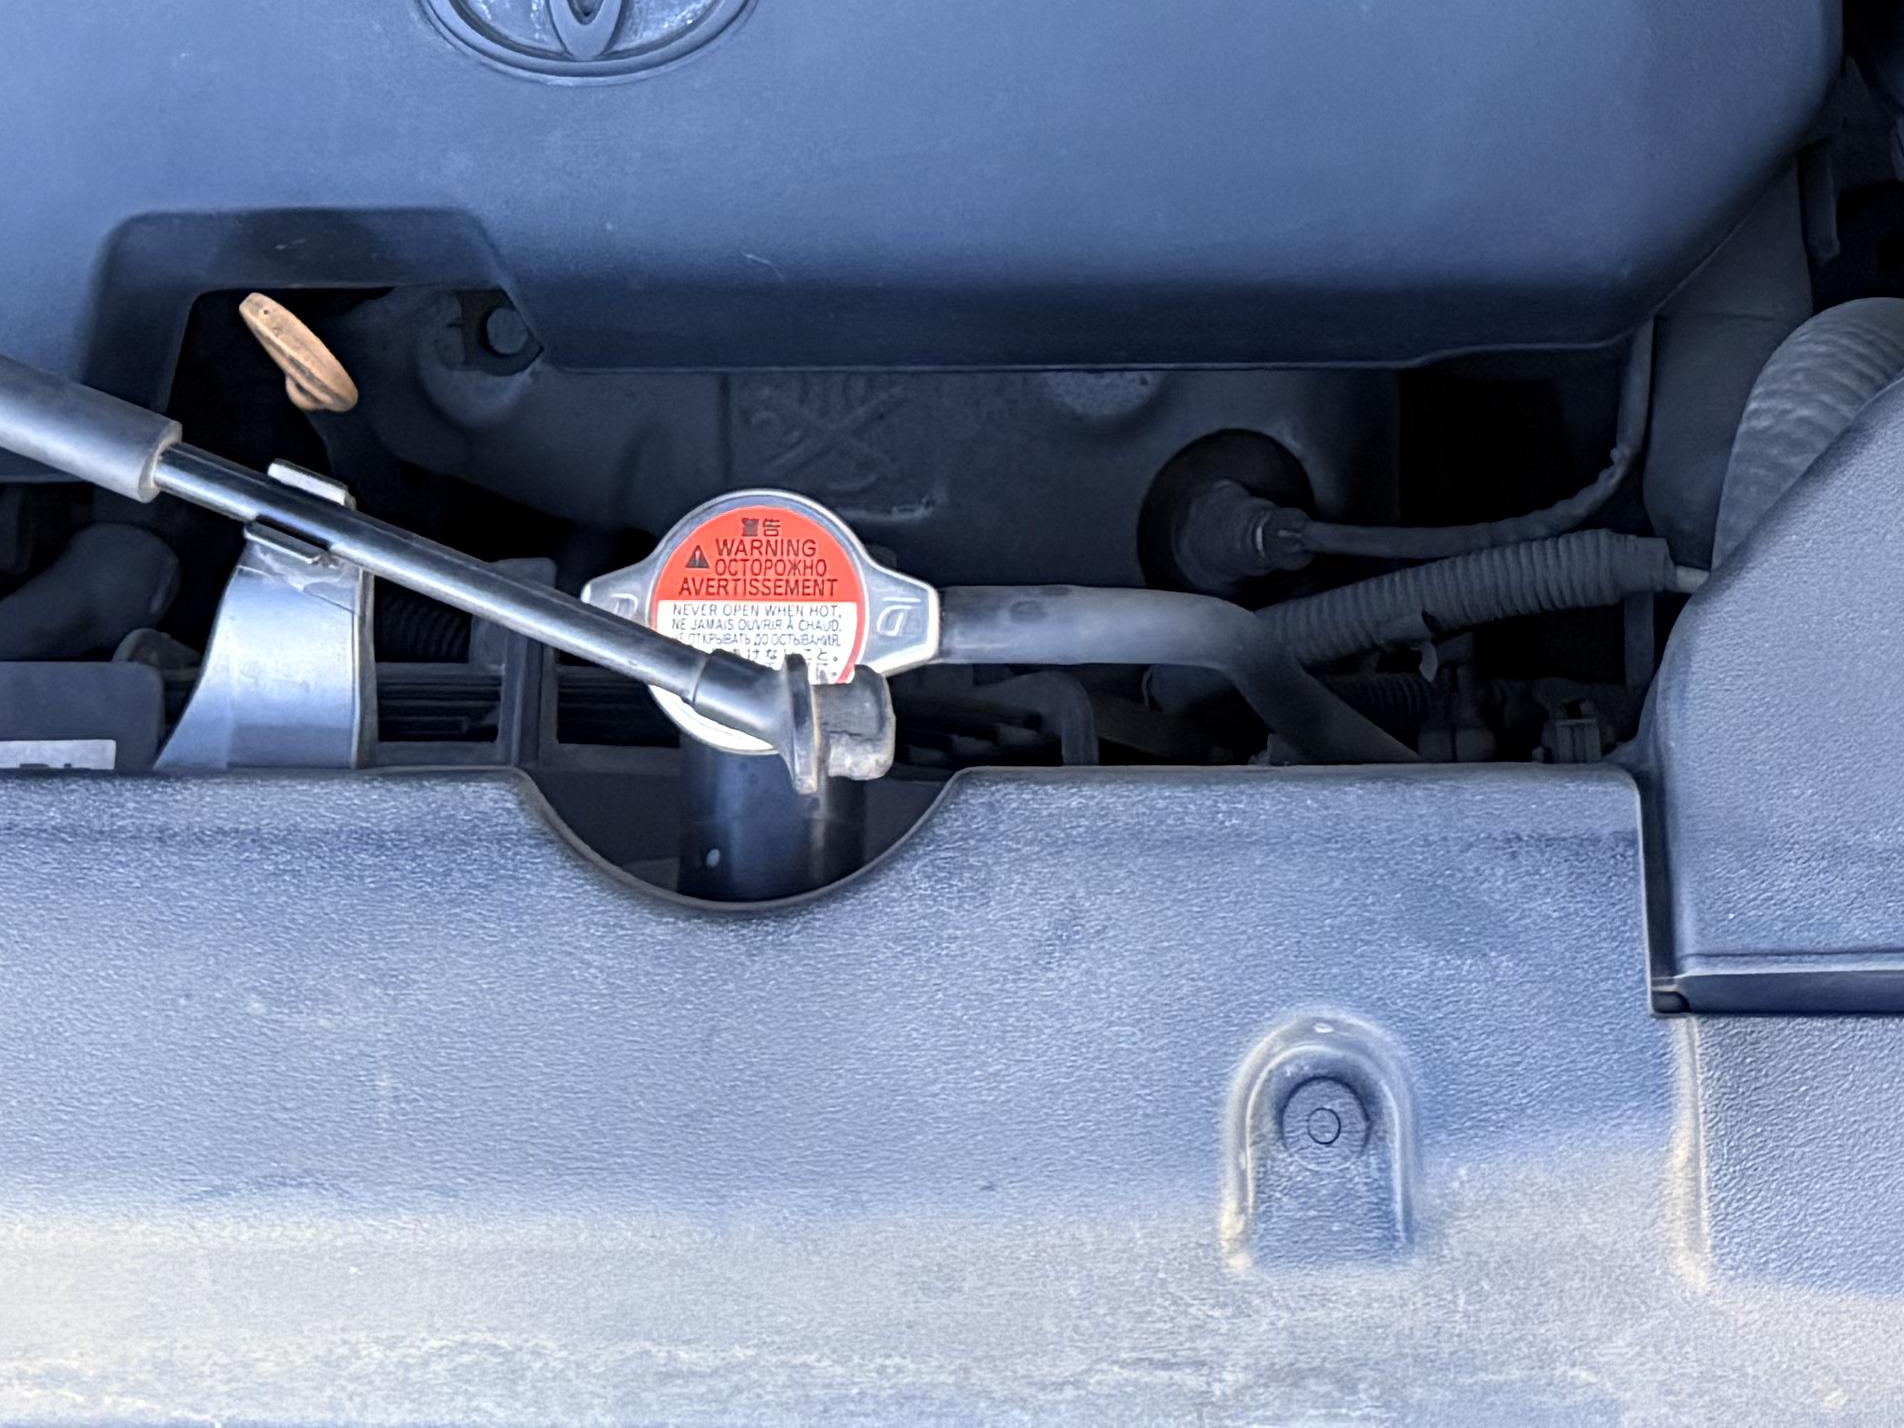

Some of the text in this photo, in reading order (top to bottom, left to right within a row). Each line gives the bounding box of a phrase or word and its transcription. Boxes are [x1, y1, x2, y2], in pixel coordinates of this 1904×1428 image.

[715, 538, 817, 557] WARNING
[714, 558, 828, 577] ОСТОРОЖНО
[678, 577, 839, 597] AVERTISSEMENT
[672, 603, 718, 617] NEVER
[722, 604, 759, 617] OPEN
[765, 604, 804, 618] WHEN
[671, 618, 686, 631] NE
[689, 618, 734, 631] JAMAIS
[737, 619, 783, 631] OUVRIR
